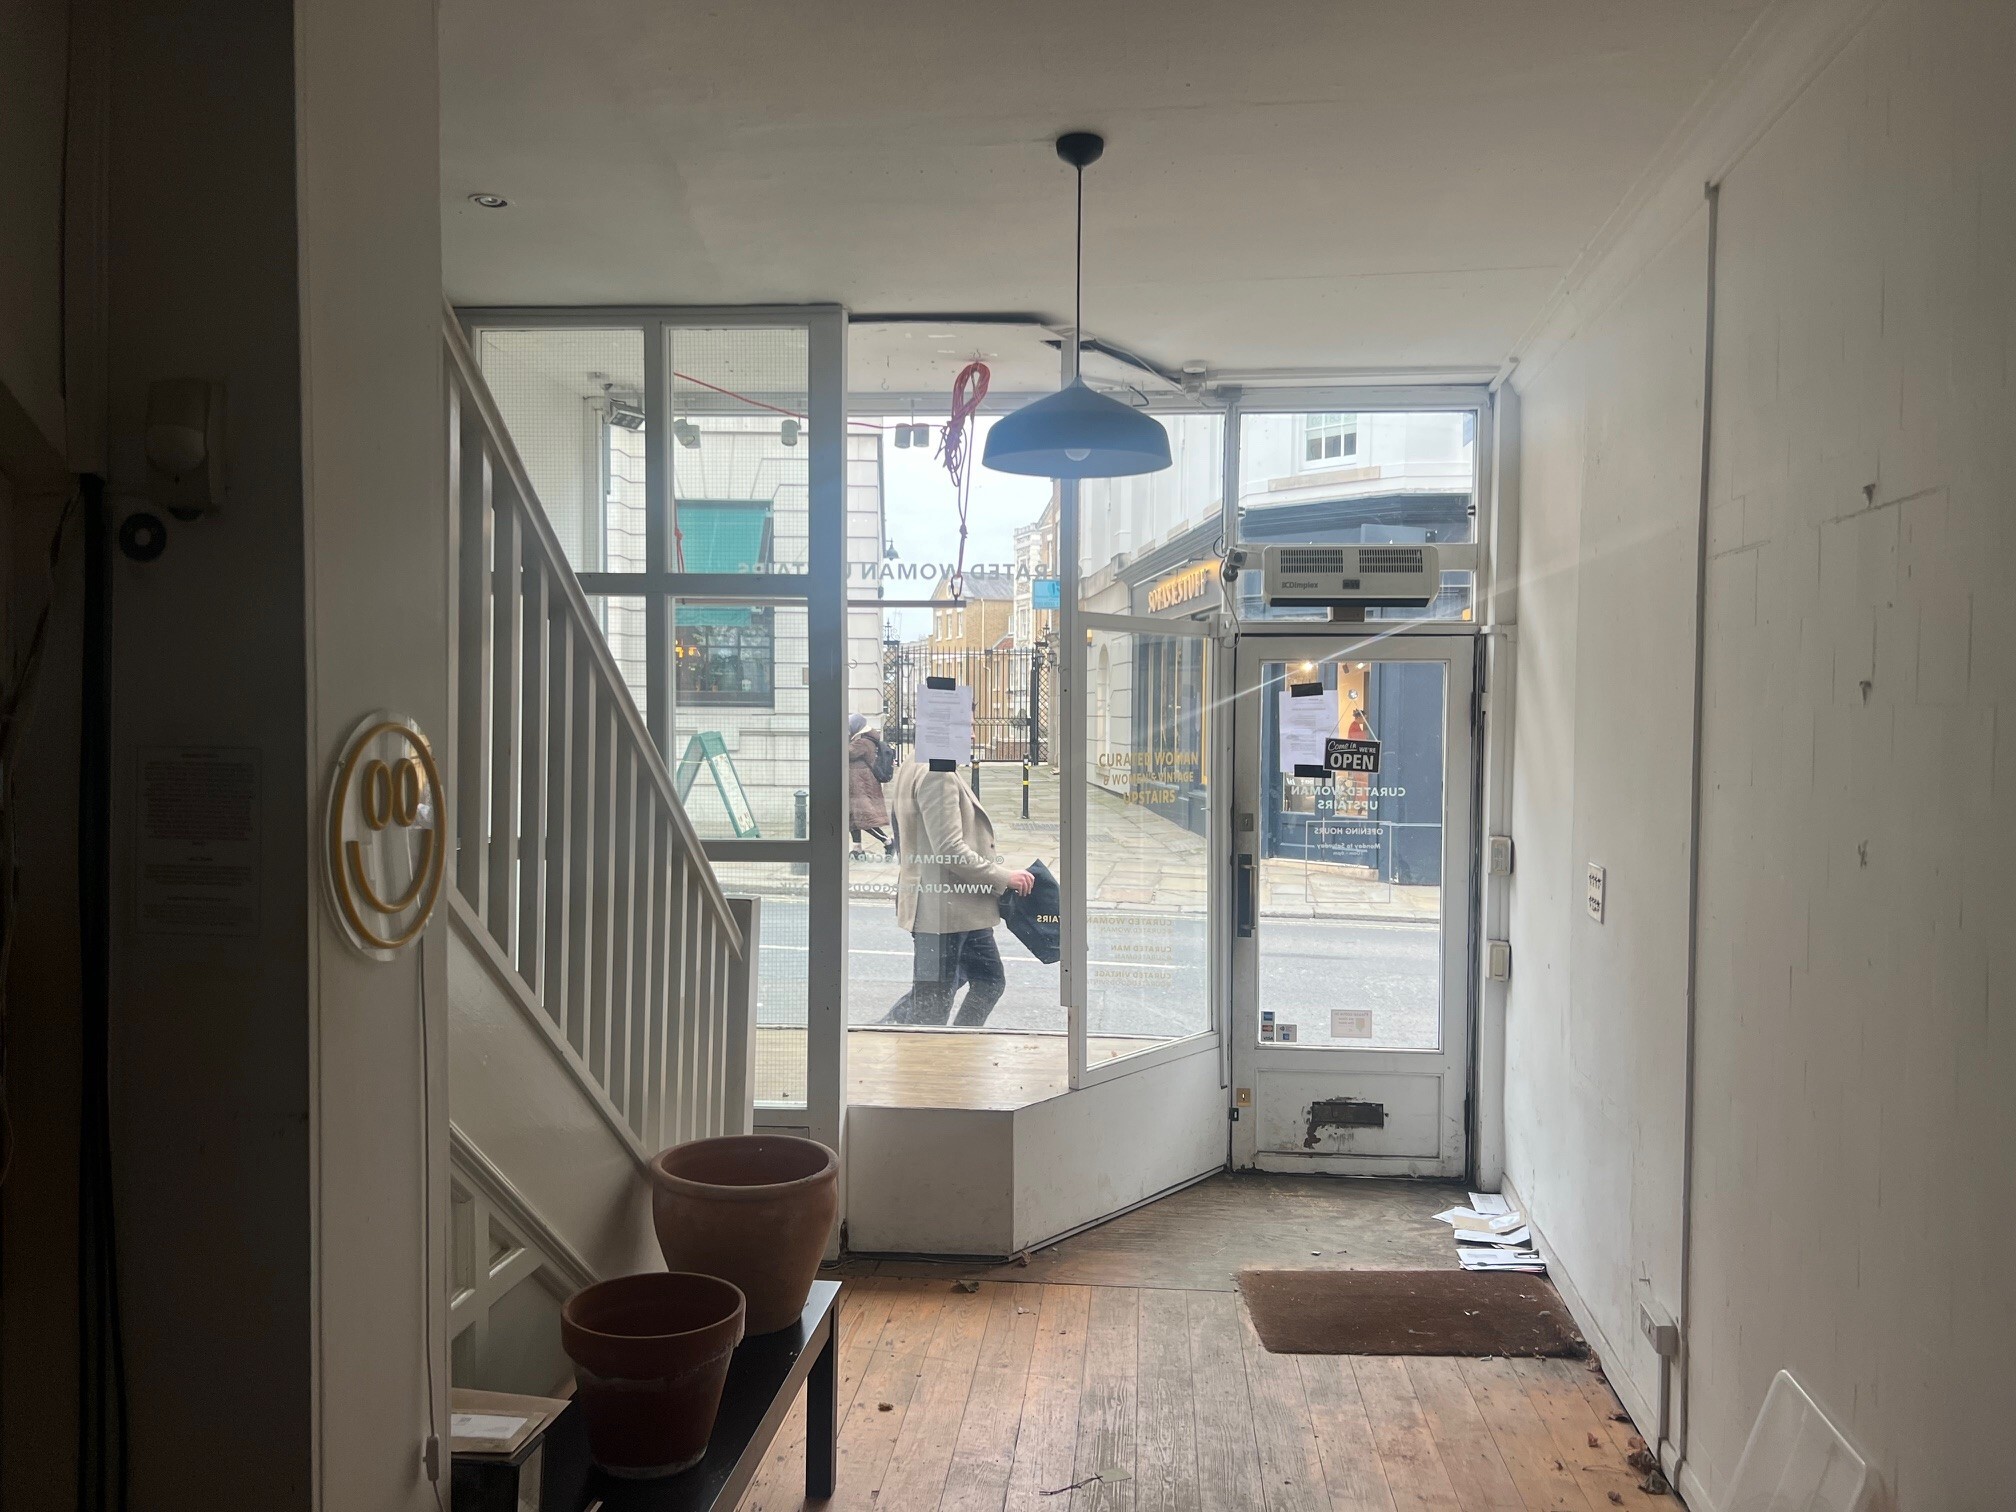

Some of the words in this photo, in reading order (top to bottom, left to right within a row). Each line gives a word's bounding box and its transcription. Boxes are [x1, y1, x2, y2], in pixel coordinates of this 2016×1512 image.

[1327, 740, 1349, 752] Come
[1099, 752, 1152, 767] CURATED
[1154, 751, 1198, 766] WOMAN
[1330, 753, 1374, 771] OPEN
[1123, 790, 1176, 805] UPSTAIRS
